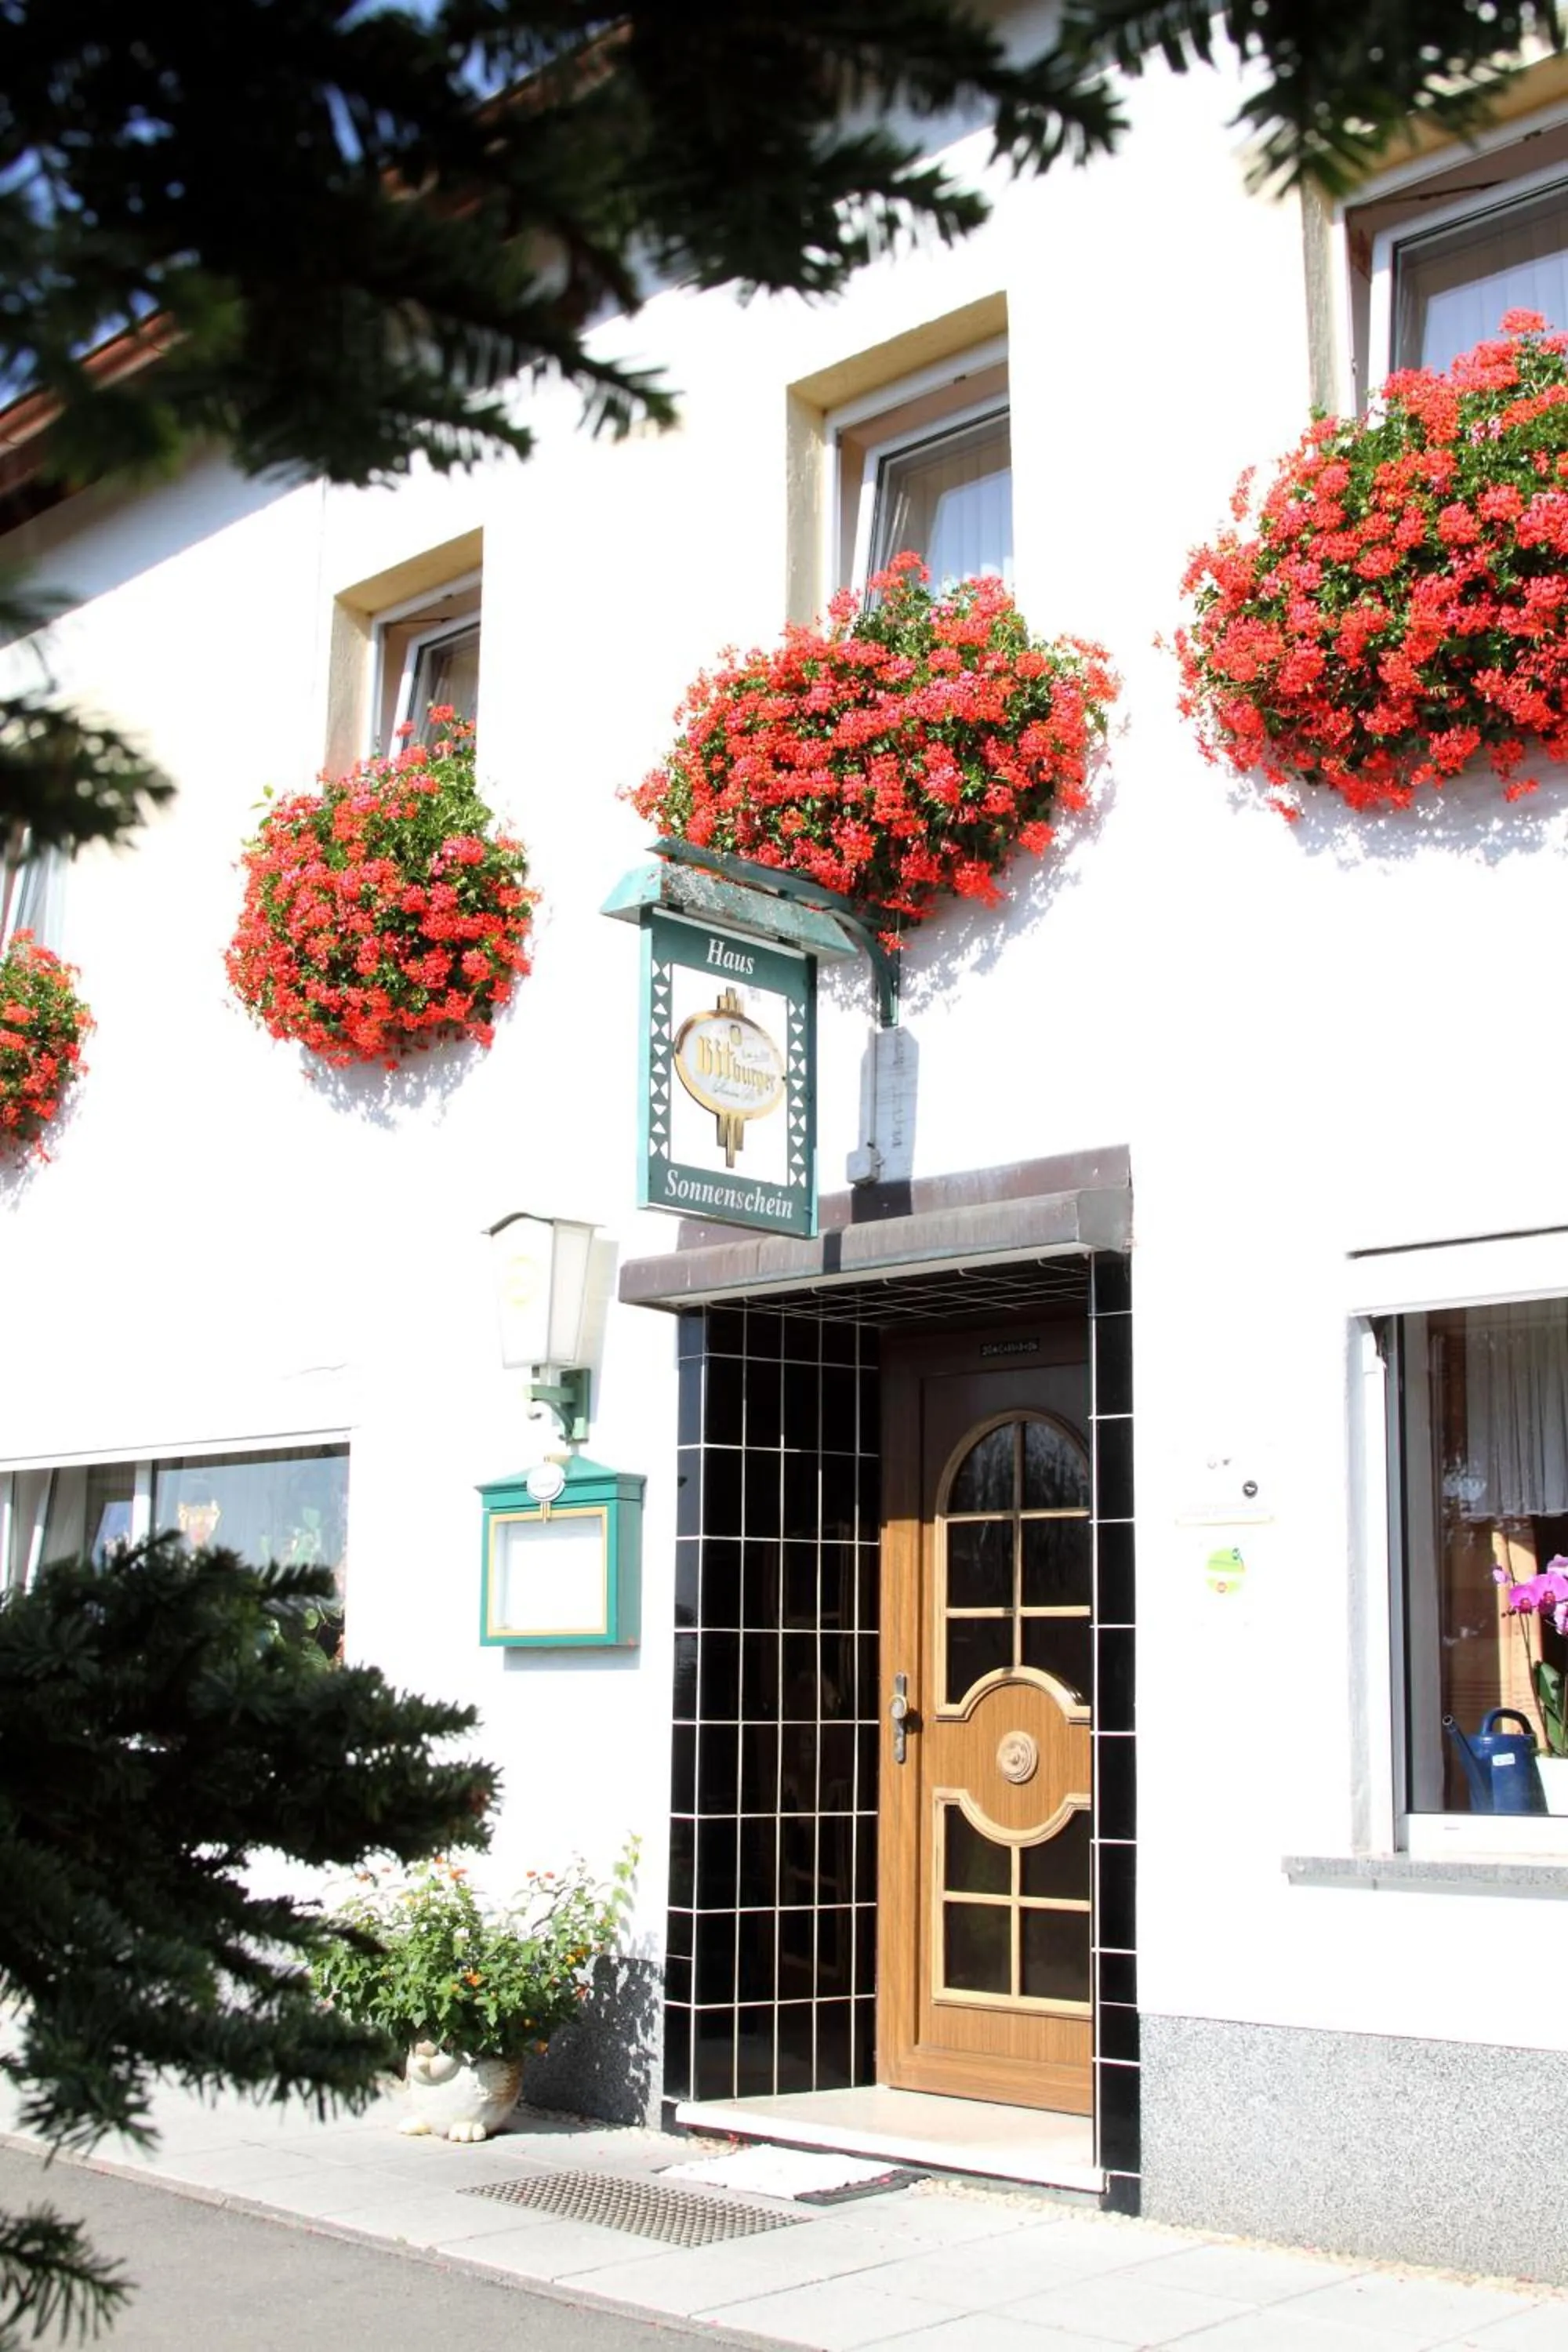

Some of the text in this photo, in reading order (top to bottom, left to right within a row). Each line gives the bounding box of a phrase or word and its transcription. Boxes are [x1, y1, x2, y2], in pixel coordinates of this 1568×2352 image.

[706, 938, 755, 975] Haus
[696, 1036, 775, 1096] Bitburger
[665, 1169, 793, 1219] Sonnenschein
